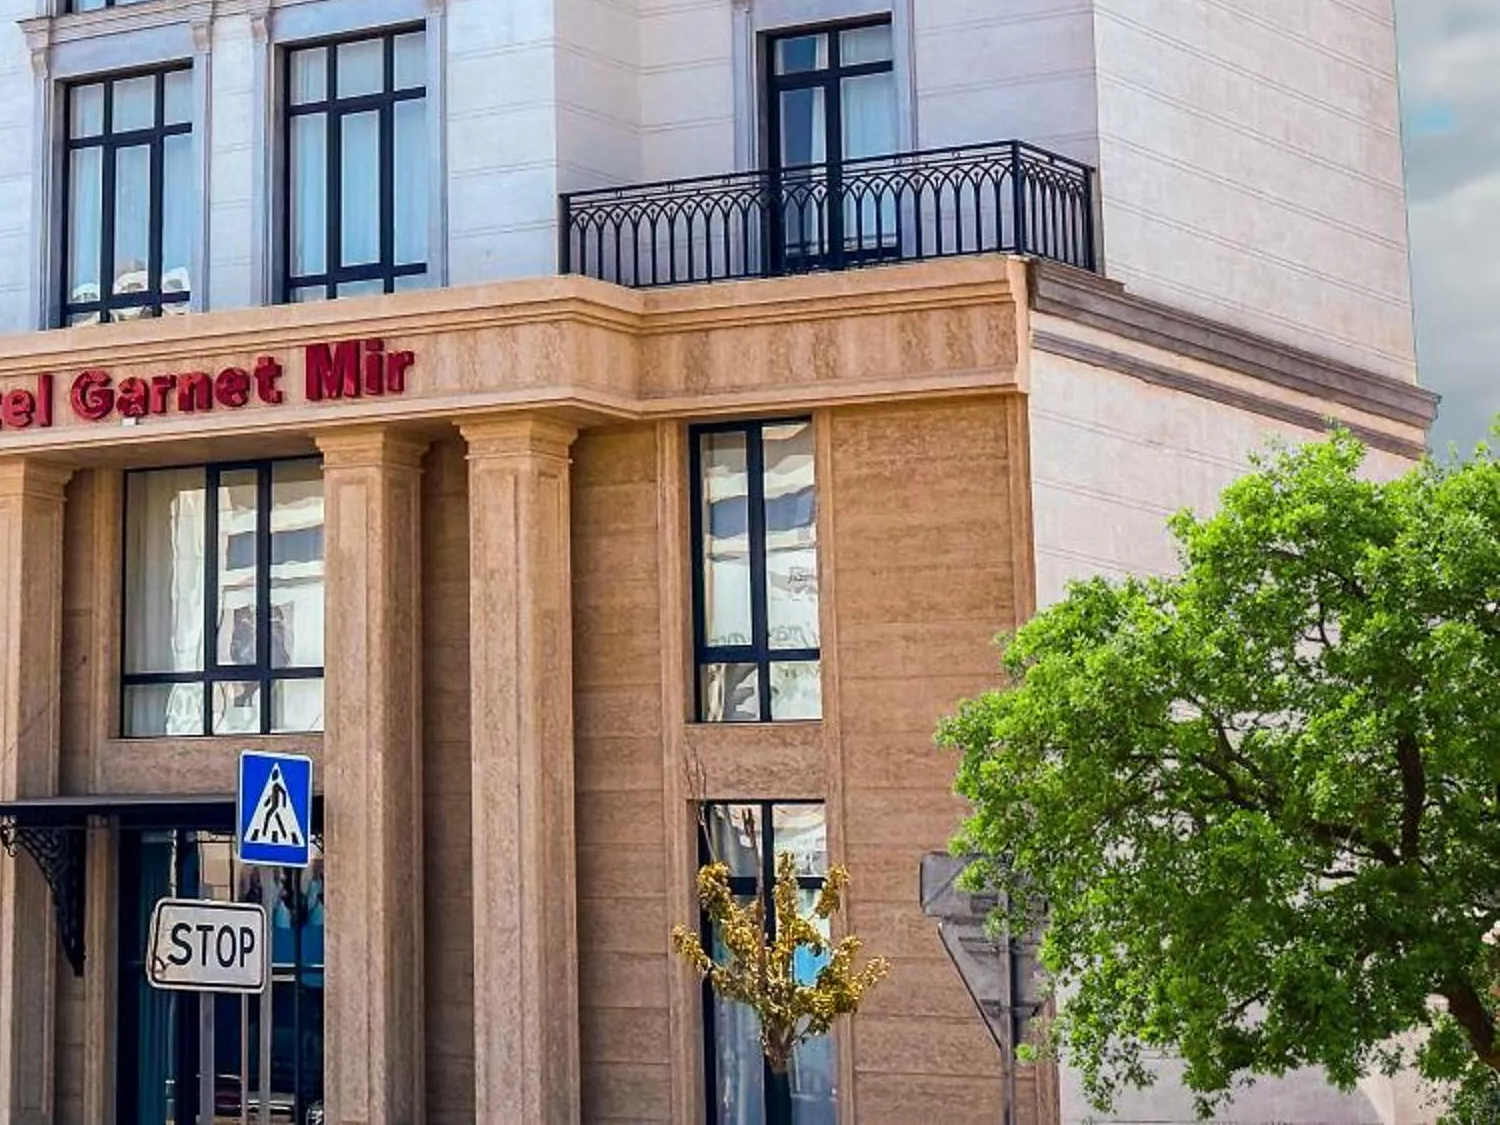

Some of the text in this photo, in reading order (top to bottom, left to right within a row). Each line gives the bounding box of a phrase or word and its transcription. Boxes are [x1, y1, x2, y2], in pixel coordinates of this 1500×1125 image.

[71, 355, 283, 421] Garnet
[305, 337, 415, 401] Mir
[167, 922, 255, 968] STOP
